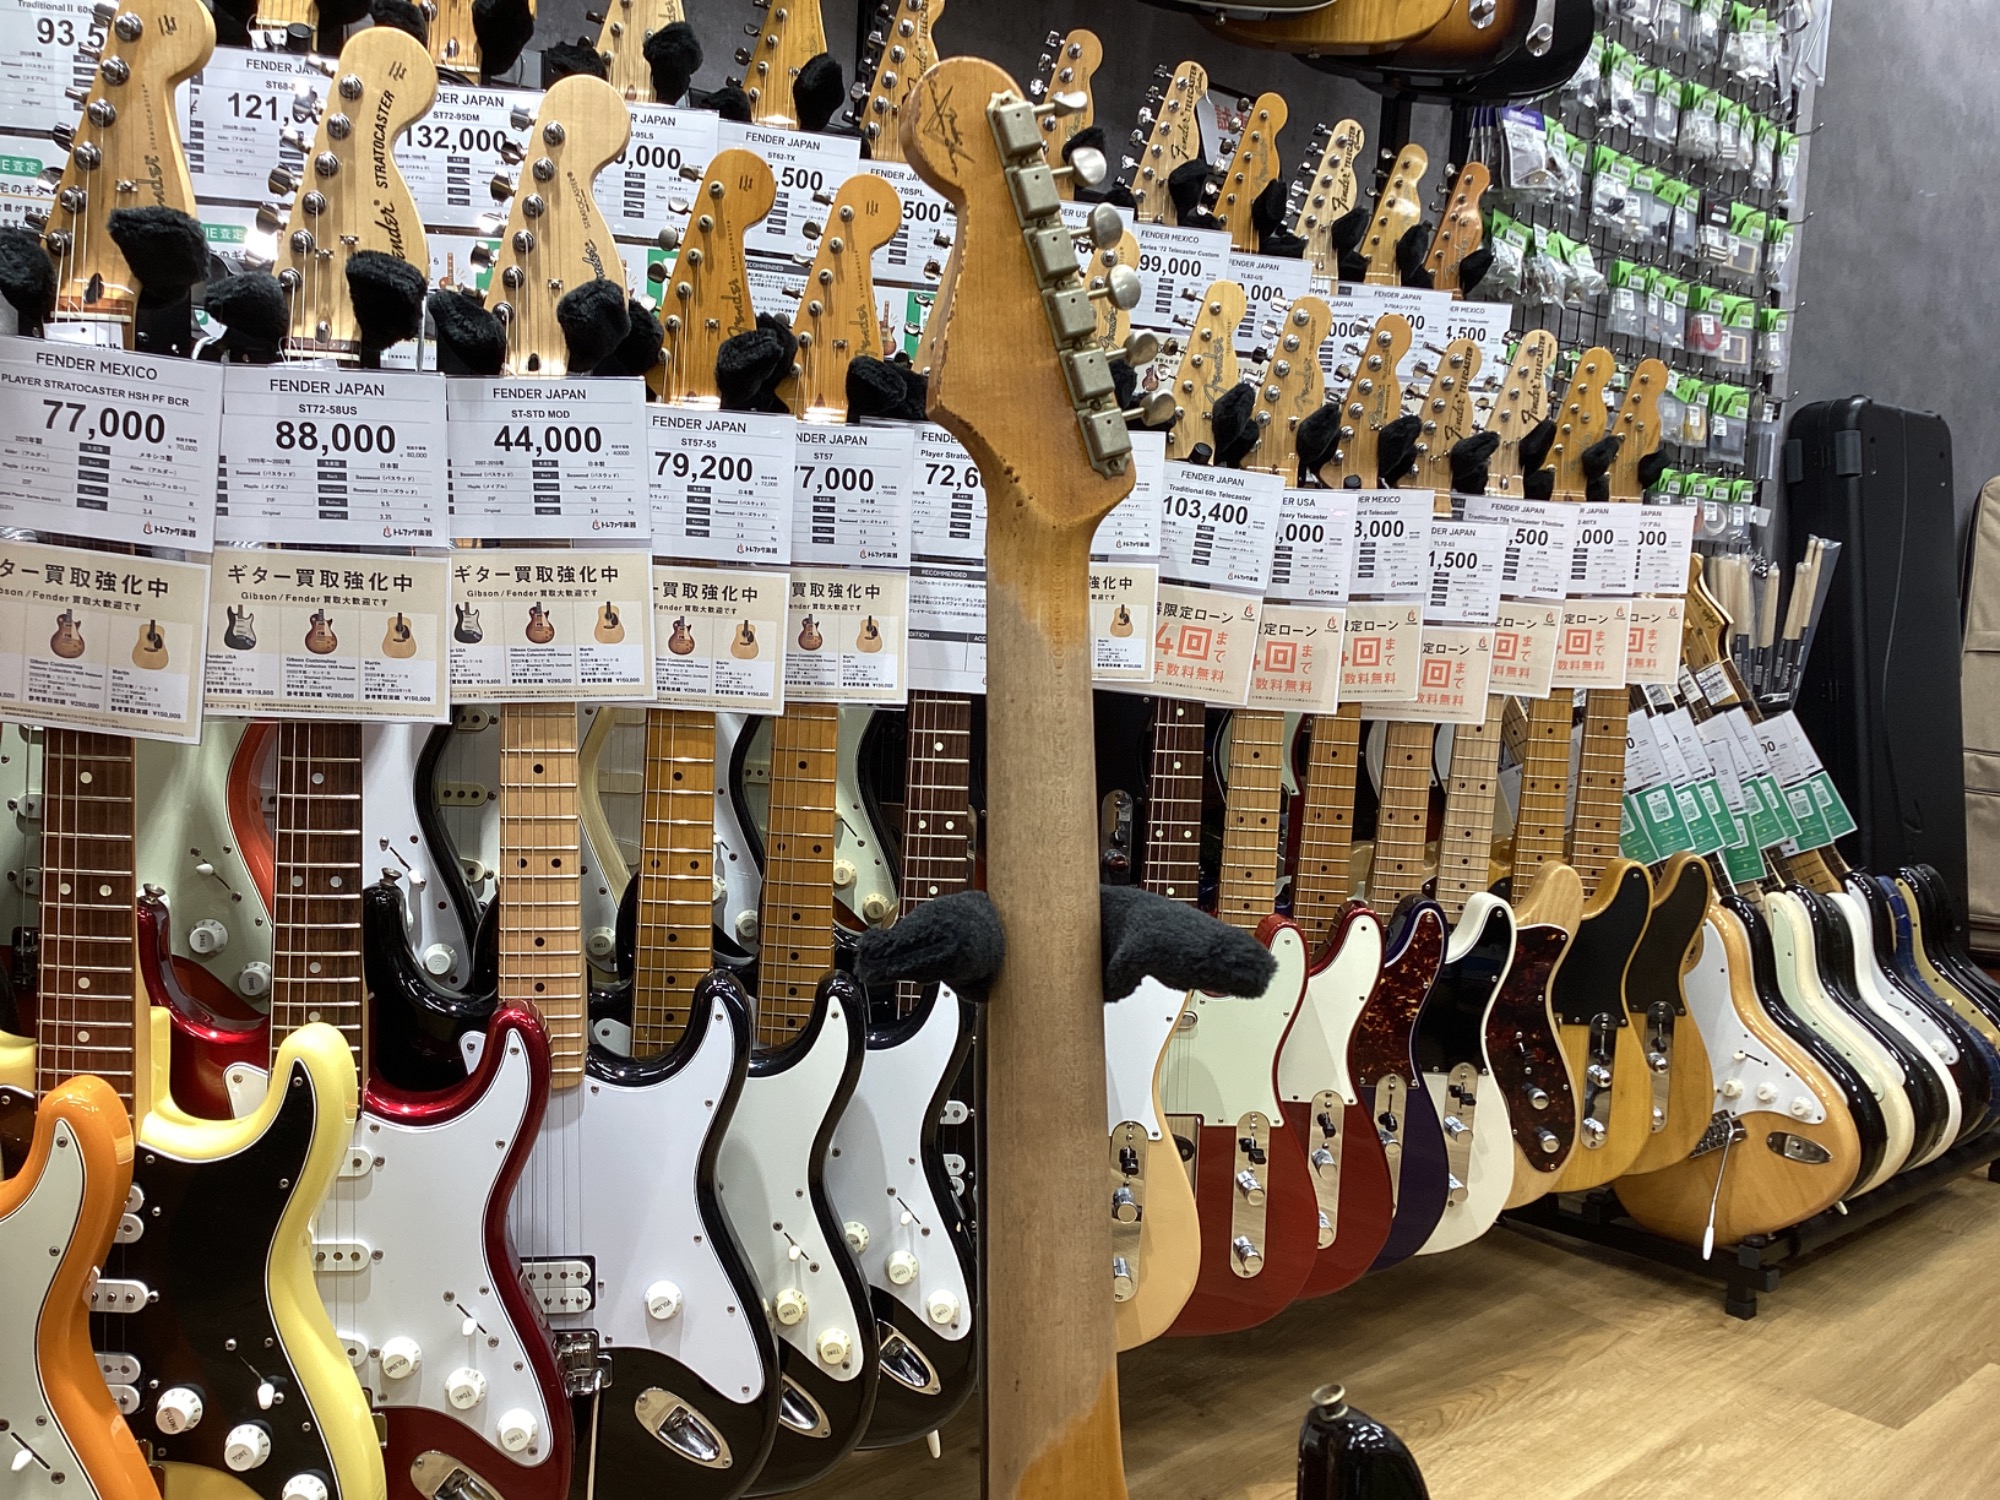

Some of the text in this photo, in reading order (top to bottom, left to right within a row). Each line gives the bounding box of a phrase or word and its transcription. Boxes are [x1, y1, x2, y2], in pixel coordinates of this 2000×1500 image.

[18, 0, 65, 12] Traditional
[246, 59, 293, 72] FENDER
[1185, 65, 1198, 114] TELECASTER
[462, 96, 504, 107] JAPAN
[641, 115, 676, 127] JAPAN
[373, 90, 395, 189] STRATOCASTER
[746, 132, 820, 150] FENDER JAPAN
[374, 202, 405, 260] ender
[1141, 230, 1199, 244] FENDER MEXICO
[1140, 254, 1201, 278] 99,000
[1256, 263, 1280, 271] JAPAN
[1374, 290, 1422, 301] FENDER JAPAN
[1463, 306, 1485, 314] MEXICO
[36, 352, 158, 380] FENDER MEXICO
[1459, 347, 1473, 394] TELECASTER
[1, 374, 190, 407] PLAYER STRATOCASTER HSH PF BCR
[270, 379, 385, 397] FENDER JAPAN
[493, 388, 586, 400] FENDER JAPAN
[298, 404, 358, 415] ST72-58US
[511, 410, 570, 419] ST-STD MOD
[43, 399, 165, 444] 77,000
[652, 415, 746, 433] FENDER JAPAN
[276, 421, 396, 457] 88,000
[494, 425, 602, 457] 44,000
[681, 438, 717, 448] ST57-55
[796, 433, 868, 445] NDER JAPAN
[921, 431, 960, 444] FENDE
[813, 452, 833, 460] ST57
[920, 449, 943, 459] Player
[655, 451, 753, 483] 79,200
[795, 466, 874, 493] 7,000
[1181, 470, 1245, 487] FENDER JAPAN
[1169, 484, 1204, 495] Traditional
[1218, 490, 1252, 502] Telecaster
[1371, 495, 1401, 503] MEXICO
[1163, 495, 1248, 525] 103,400
[1297, 498, 1316, 507] USA
[1491, 503, 1545, 514] FENDER JAPAN
[1276, 523, 1324, 545] ,000
[0, 558, 169, 598] ター買取強化中
[228, 564, 413, 593] ギター買取強化中
[454, 565, 619, 583] ギター買取強化中
[921, 569, 967, 578] RECOMMENDED
[540, 589, 598, 597] 買取大歓迎です
[792, 582, 881, 600] 買取強化中
[72, 596, 141, 612] 買取大歓迎です
[323, 595, 388, 607] 買取大歓迎です
[684, 604, 737, 615] 買取大歓迎です
[1423, 642, 1469, 655] 定ローン
[1154, 661, 1224, 683] 手数料無料
[164, 1408, 179, 1432] VOLUME
[231, 1449, 248, 1462] TONE
